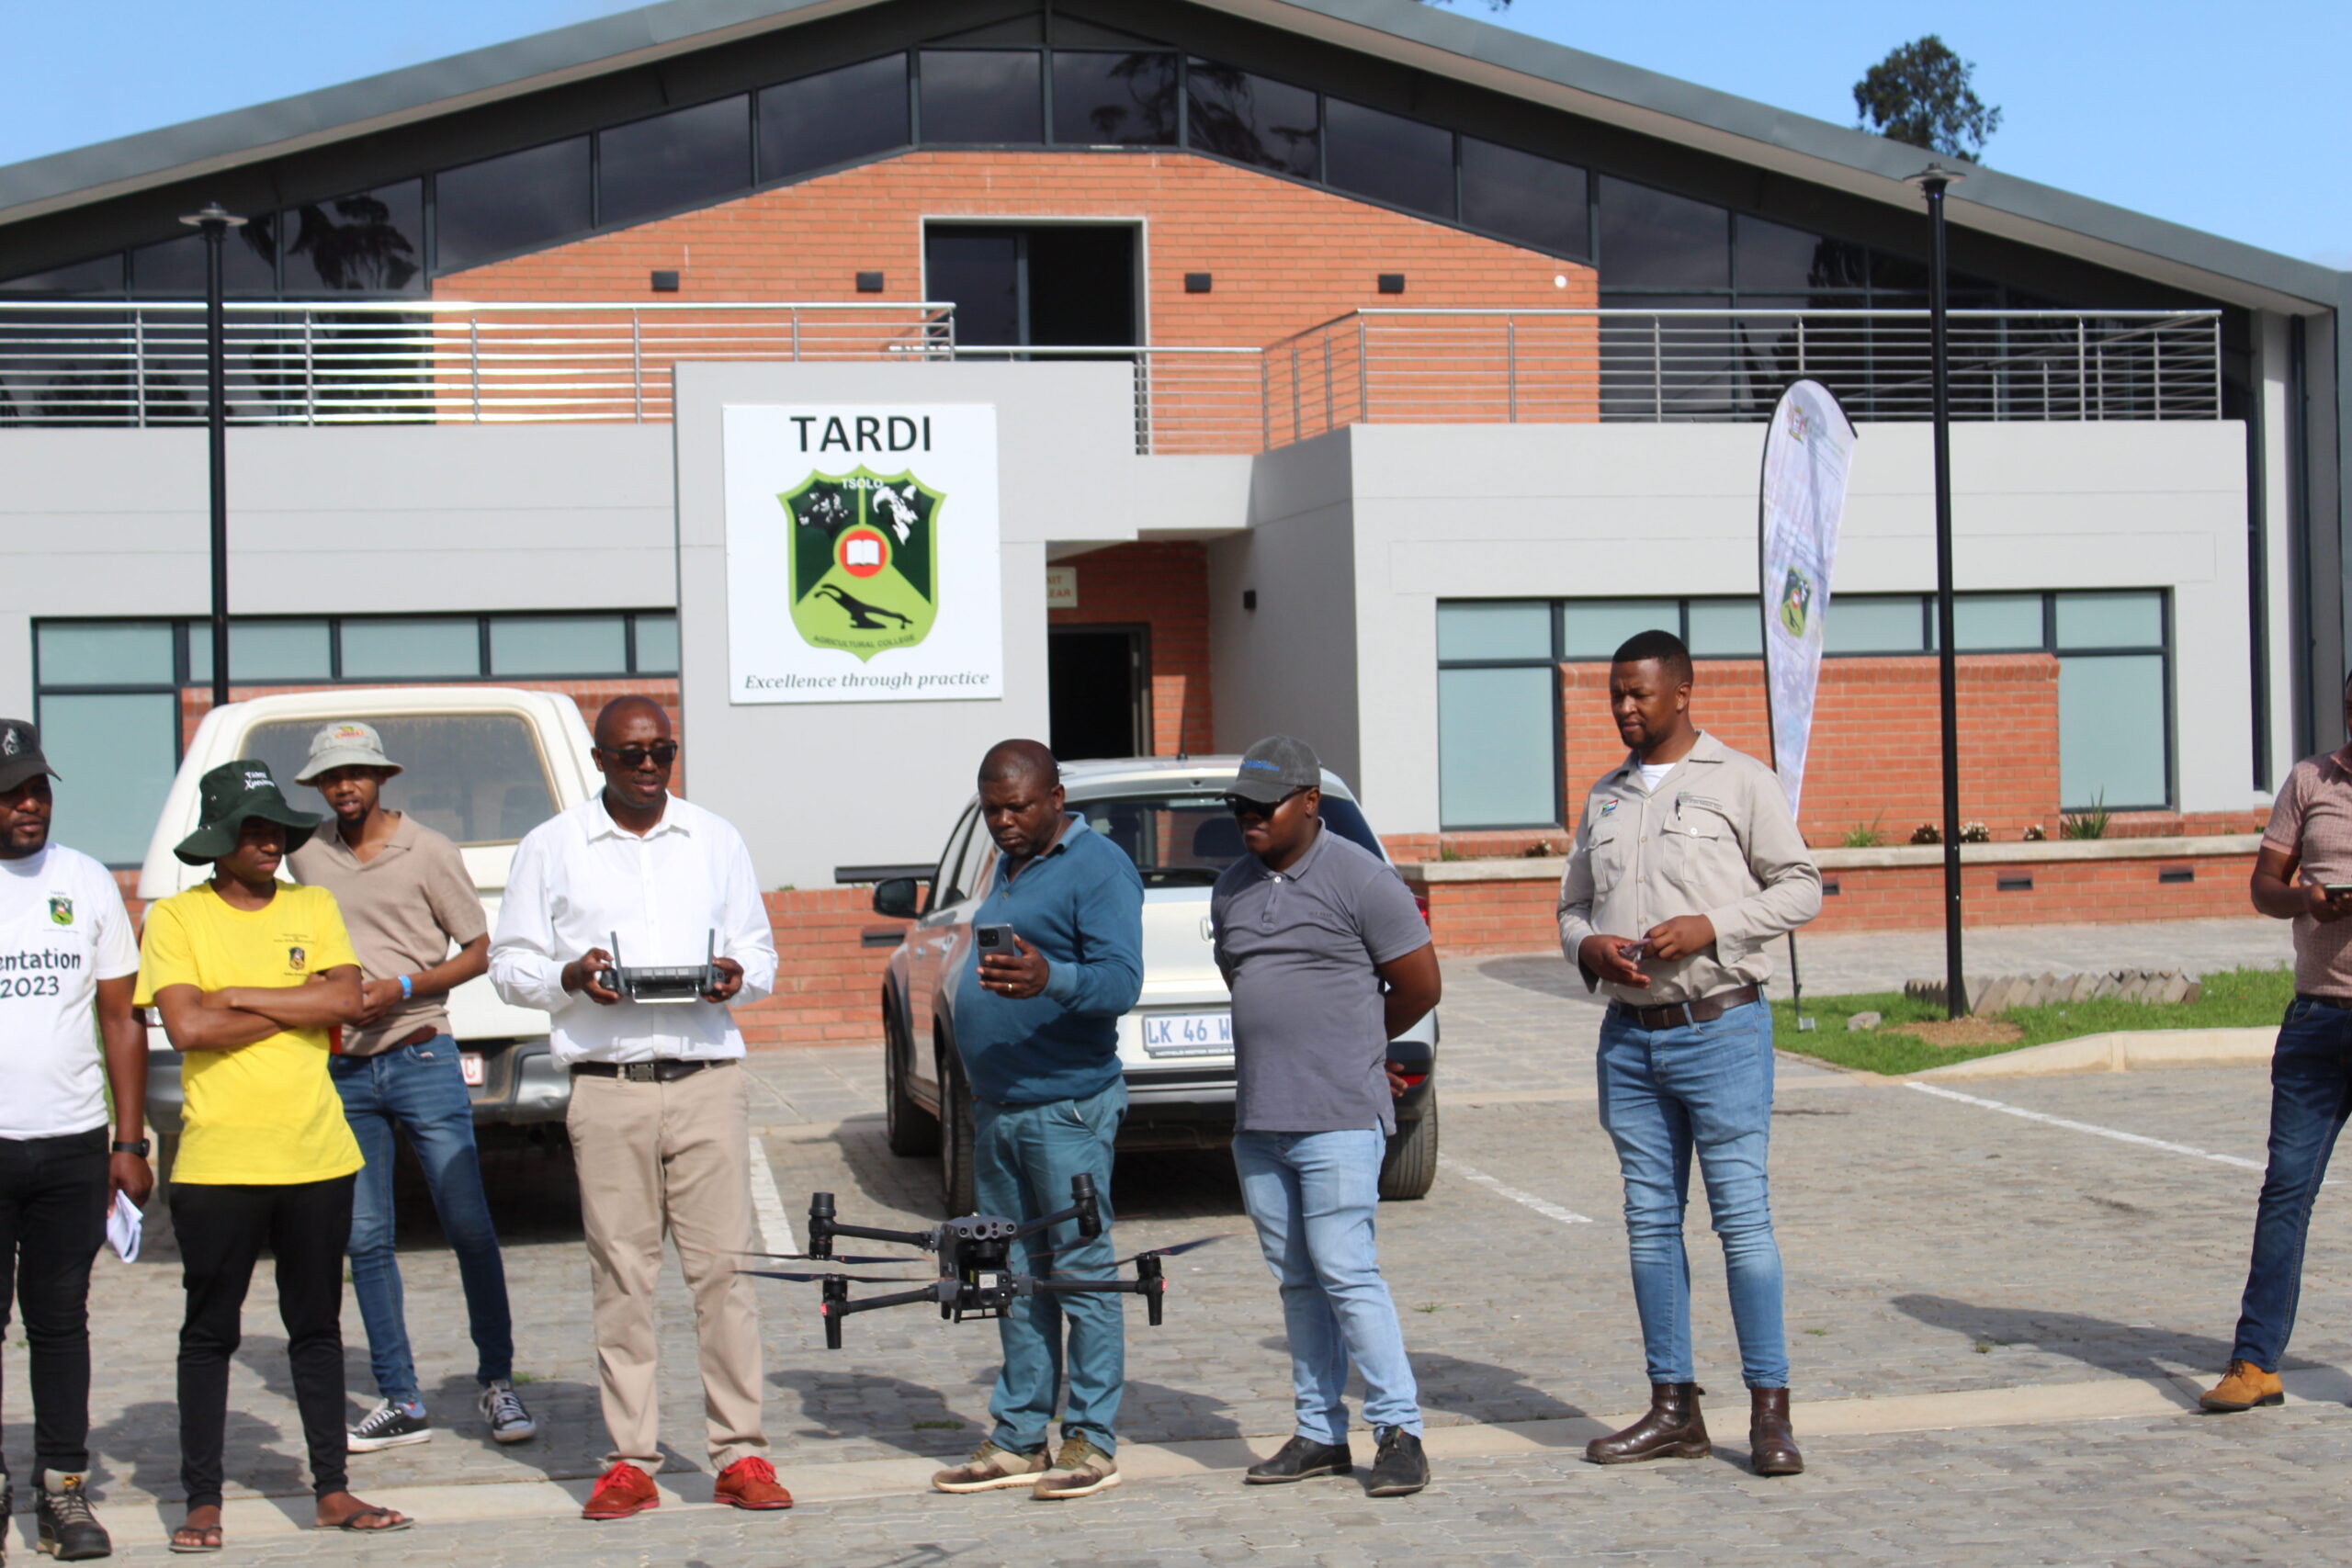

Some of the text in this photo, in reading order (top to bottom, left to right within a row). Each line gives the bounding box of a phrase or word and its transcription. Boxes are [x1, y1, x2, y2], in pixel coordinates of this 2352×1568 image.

[790, 416, 930, 451] TARDI
[842, 478, 884, 490] TSOLO
[813, 634, 915, 649] AGRICULTURAL COLLEGE
[745, 671, 989, 689] Excellence through practice
[0, 976, 60, 998] 2023
[1148, 1021, 1171, 1043] LK
[1183, 1020, 1207, 1041] 46
[465, 1056, 476, 1078] C
